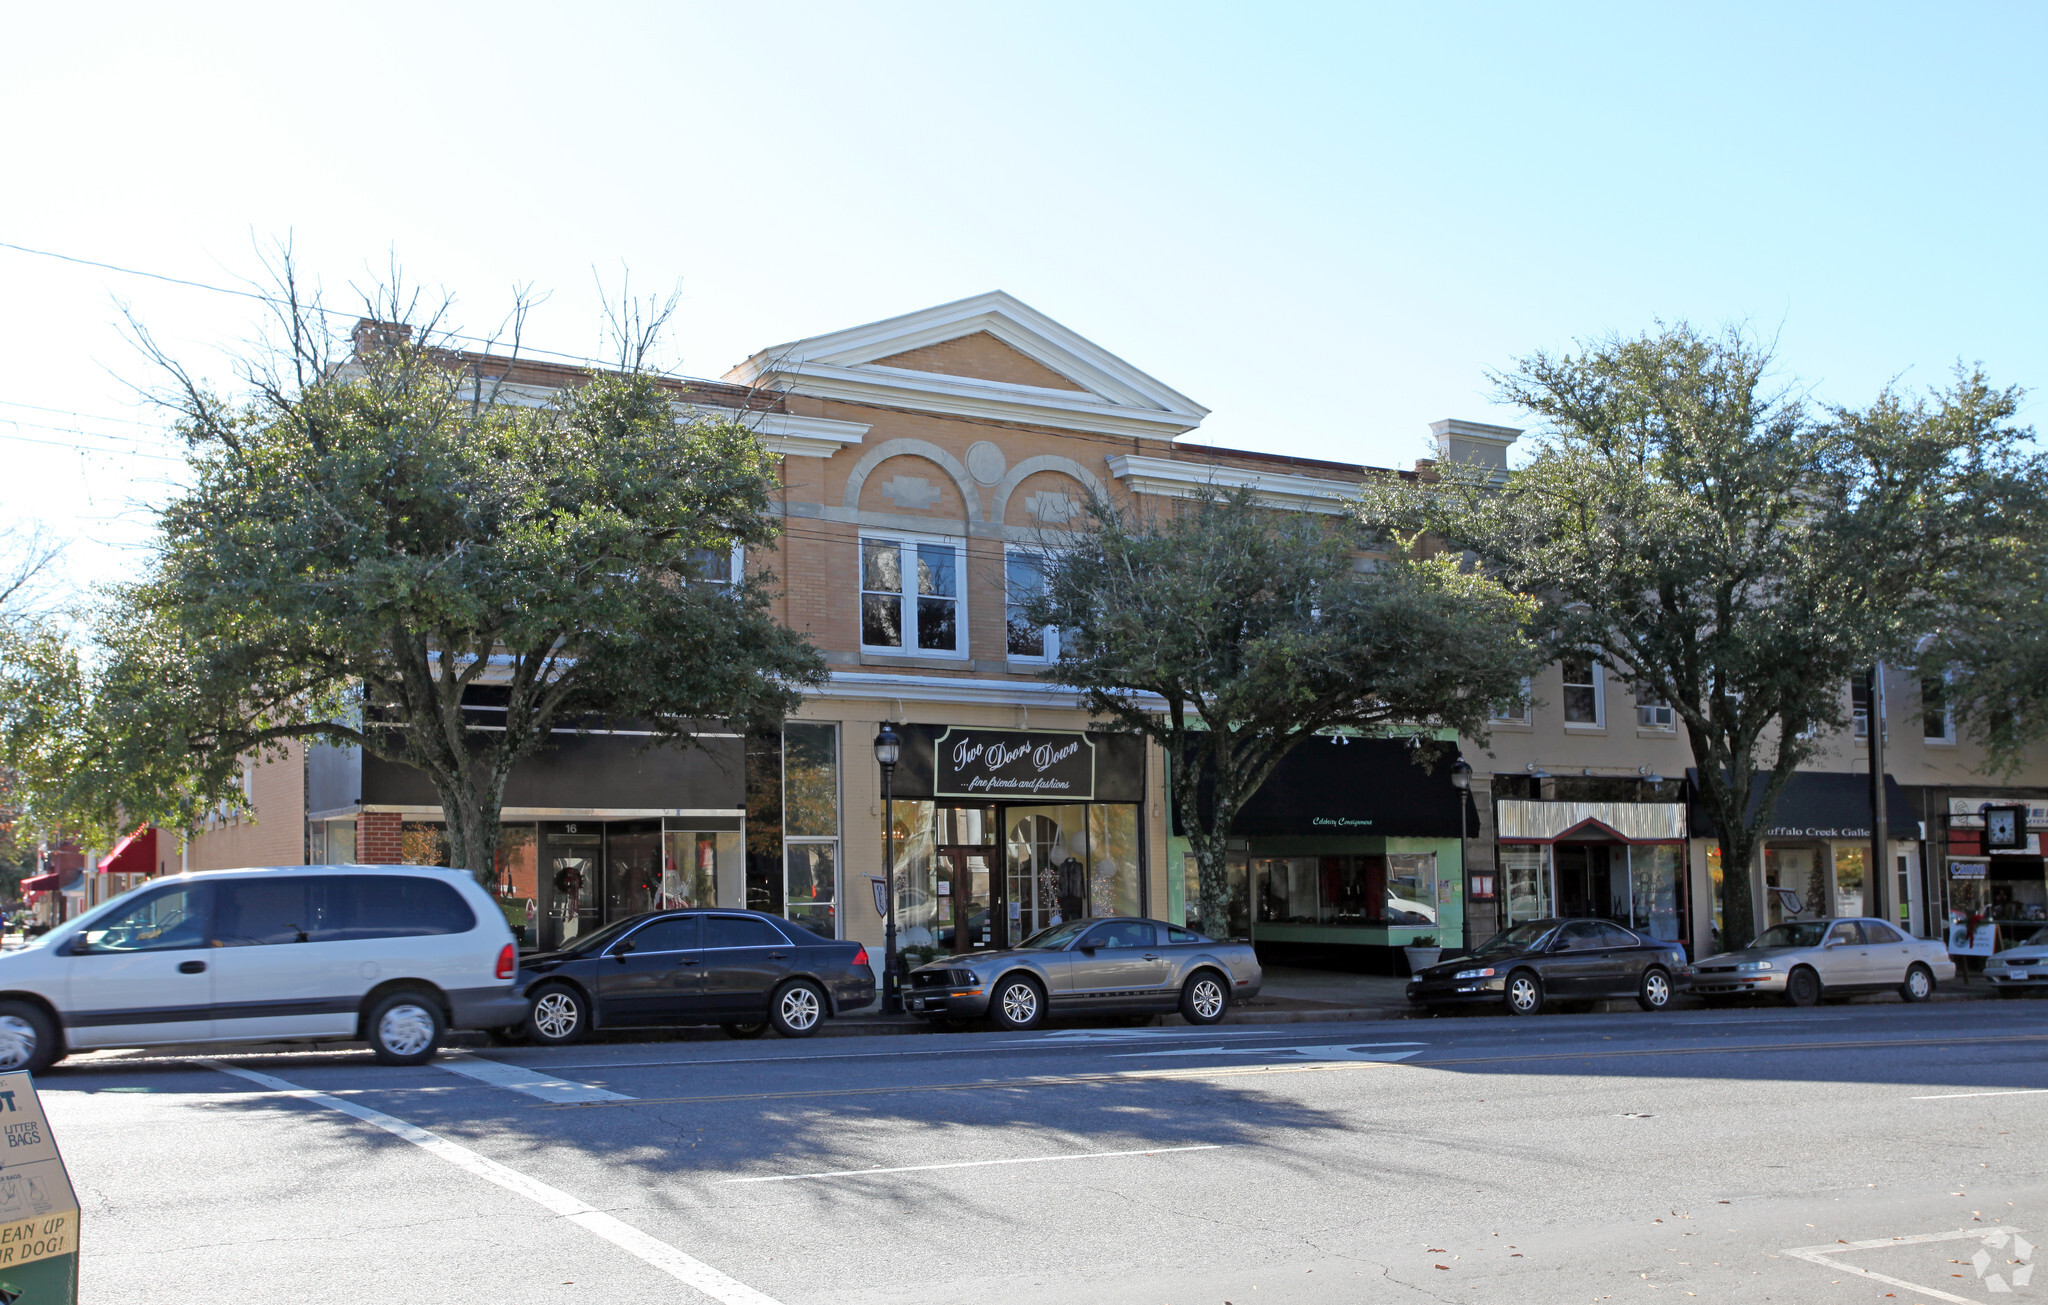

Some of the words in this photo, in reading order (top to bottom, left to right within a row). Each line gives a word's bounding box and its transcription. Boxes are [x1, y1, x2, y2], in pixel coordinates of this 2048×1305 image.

[953, 737, 984, 771] Two
[985, 741, 1032, 771] Doors
[1033, 741, 1079, 772] Down
[986, 776, 1017, 791] friends
[1018, 778, 1036, 788] and
[1033, 778, 1070, 792] fashions
[565, 823, 577, 834] 16
[1312, 817, 1337, 827] Celebrity
[1338, 817, 1373, 827] Consignment
[1764, 827, 1803, 837] uffalo
[1805, 828, 1838, 837] Creek
[1841, 828, 1871, 837] Galle
[1950, 862, 1986, 875] Canon
[4, 1121, 38, 1135] LITTER
[8, 1130, 41, 1148] BAGS
[43, 1217, 64, 1235] UP
[21, 1236, 63, 1259] DOG!
